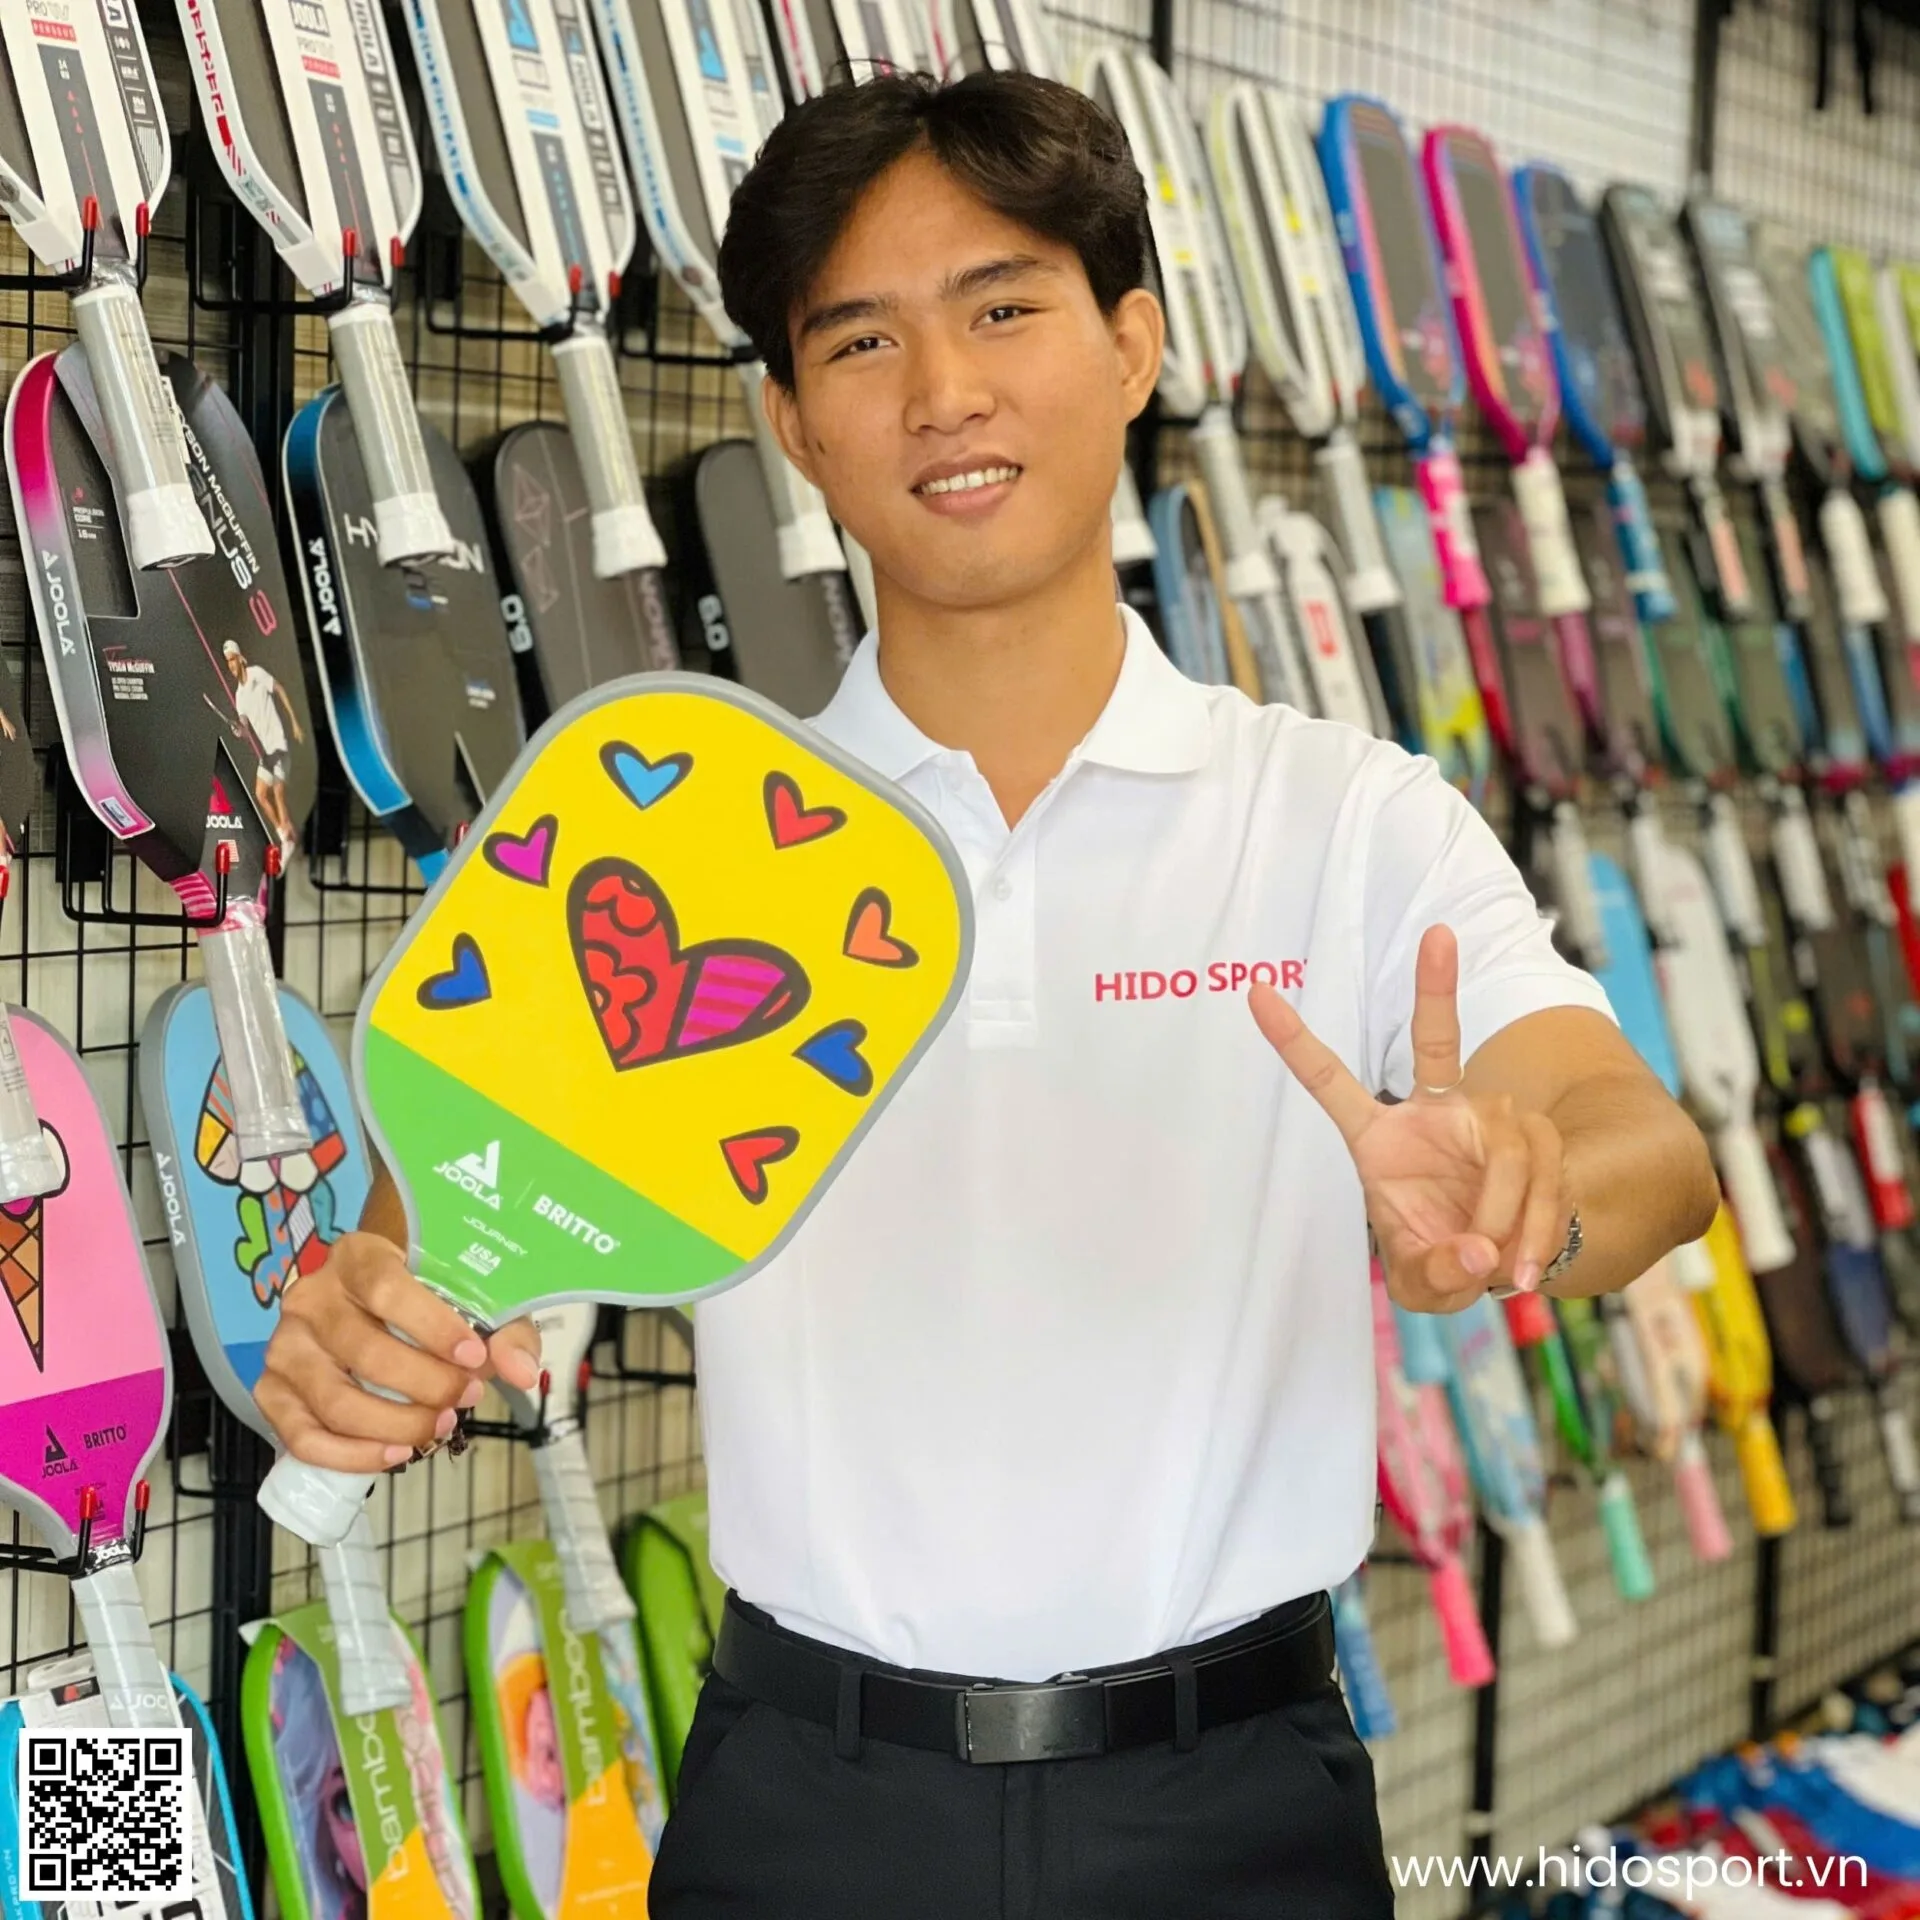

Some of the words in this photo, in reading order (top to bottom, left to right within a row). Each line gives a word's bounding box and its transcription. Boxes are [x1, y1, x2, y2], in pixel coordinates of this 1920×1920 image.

[173, 402, 211, 473] YSON
[207, 473, 260, 575] McGUFFIN
[308, 536, 338, 616] JOOLA
[46, 571, 76, 657] JOOLA
[206, 815, 243, 829] JOOLA
[1095, 969, 1198, 1002] HIDO
[1207, 958, 1308, 992] SPOR
[159, 1172, 187, 1247] JOOLA
[432, 1161, 504, 1211] JOOLA
[462, 1215, 529, 1257] JOURNEY
[532, 1194, 621, 1255] BRITTO
[468, 1242, 502, 1269] USA
[83, 1425, 127, 1449] BRITTO
[42, 1459, 79, 1478] JOOLA
[134, 1694, 168, 1709] JOO
[355, 1710, 409, 1882] bambo
